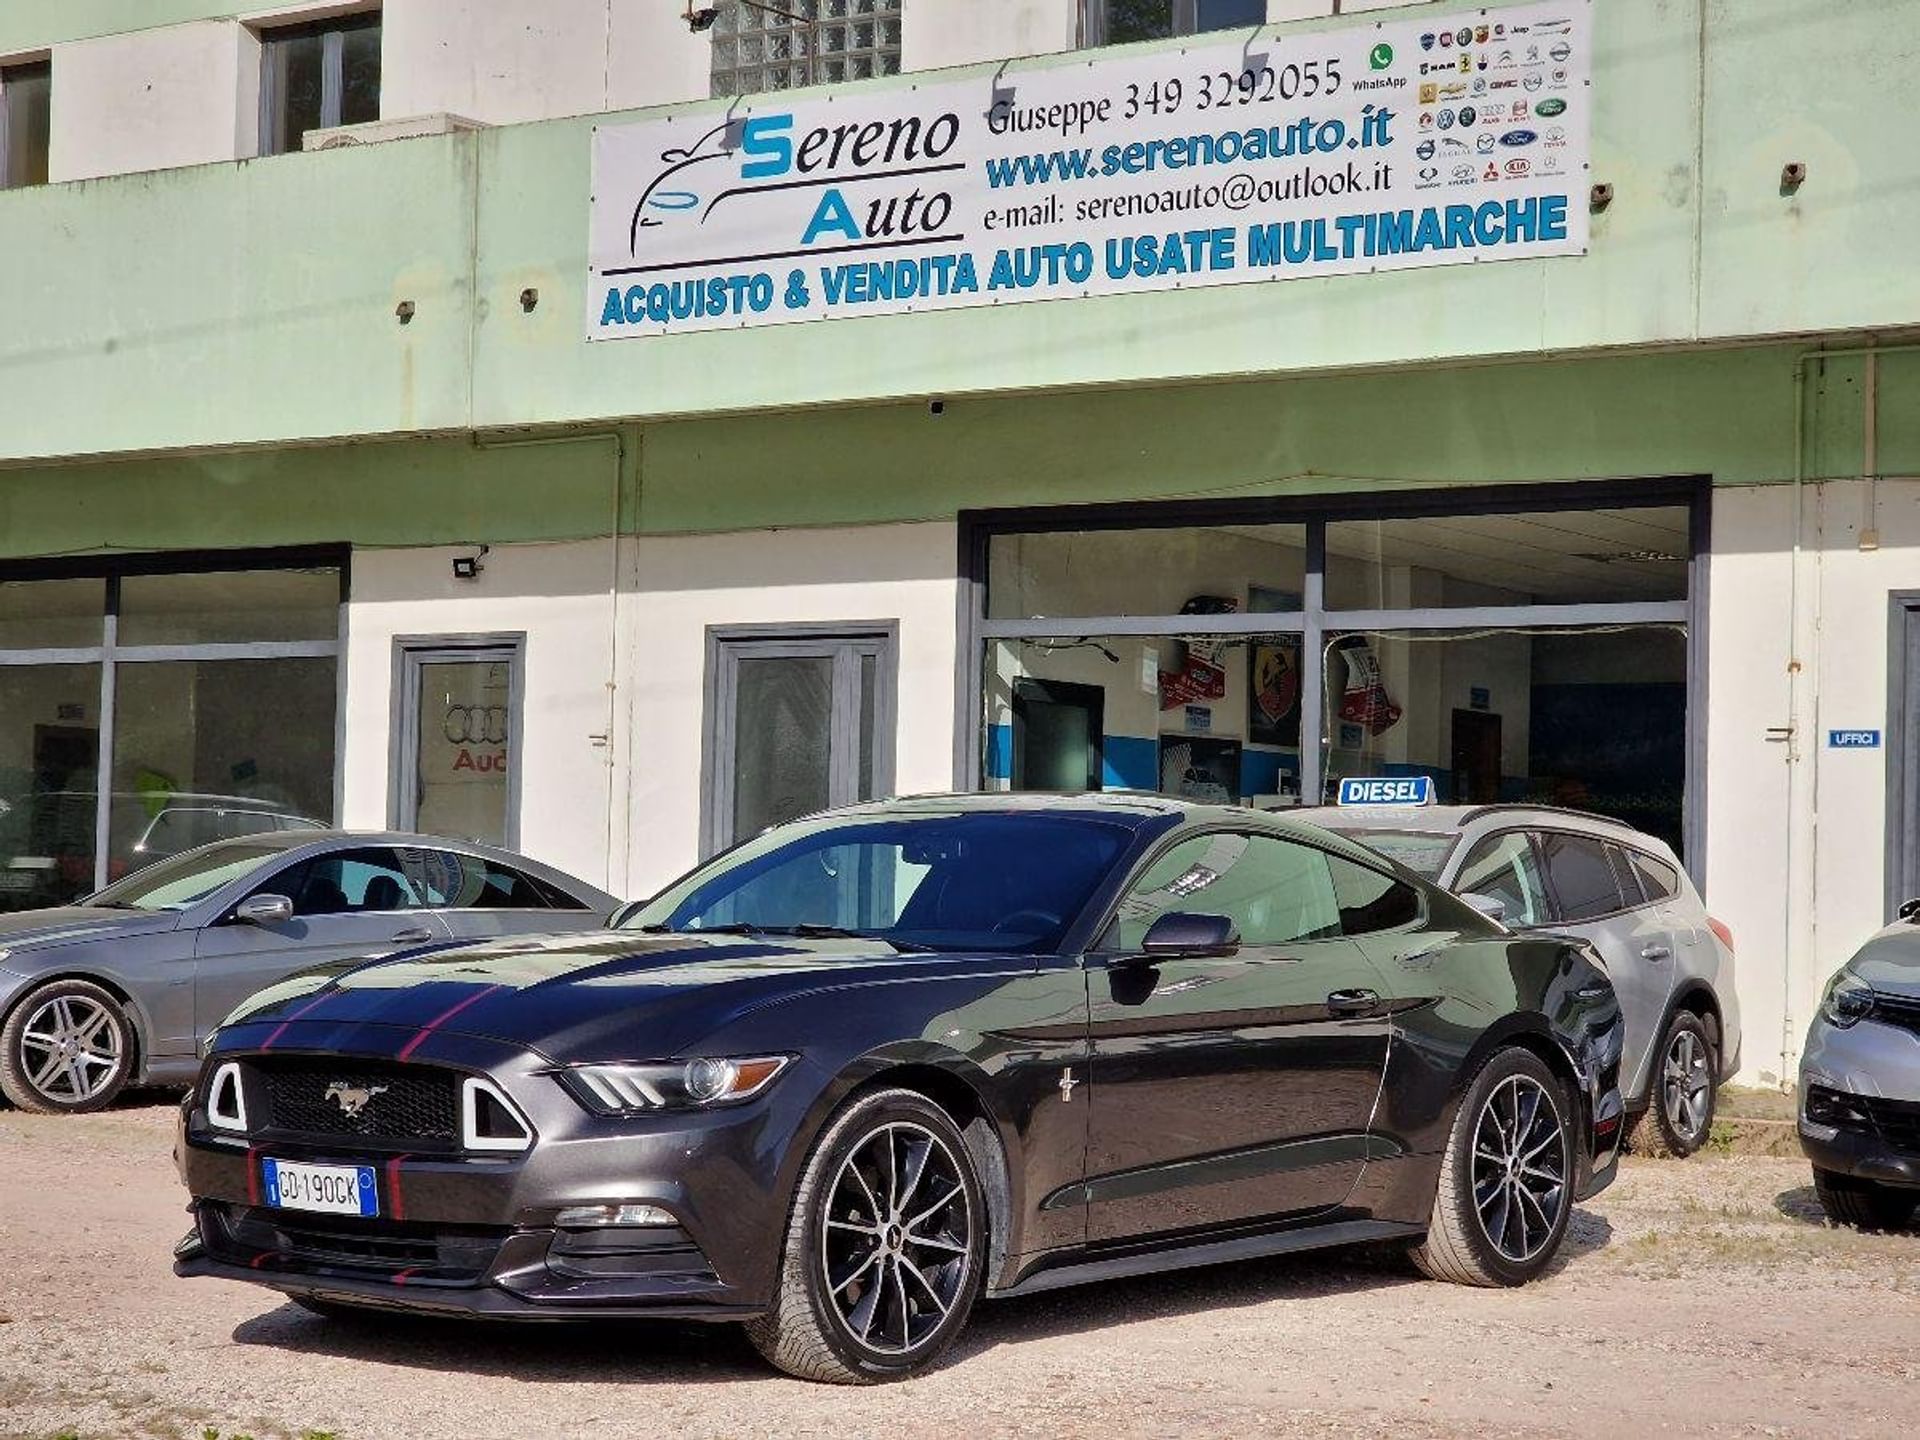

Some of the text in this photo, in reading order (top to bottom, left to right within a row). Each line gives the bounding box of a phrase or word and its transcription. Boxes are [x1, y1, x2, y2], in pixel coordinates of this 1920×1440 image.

[987, 58, 1342, 137] Giuseppe 349 3292055
[1352, 76, 1407, 92] WhatsApp
[741, 112, 960, 179] Sereno
[985, 103, 1397, 189] www.serenoauto.it
[800, 187, 953, 244] Auto
[983, 161, 1393, 231] e-mail: serenoauto@outlook.it
[600, 195, 1568, 326] ACQUISTO & VENDITA AUTO USATE MULTIMARCHE
[452, 748, 507, 772] Aud
[1836, 733, 1874, 744] UFFICI
[1349, 782, 1419, 801] DIESEL
